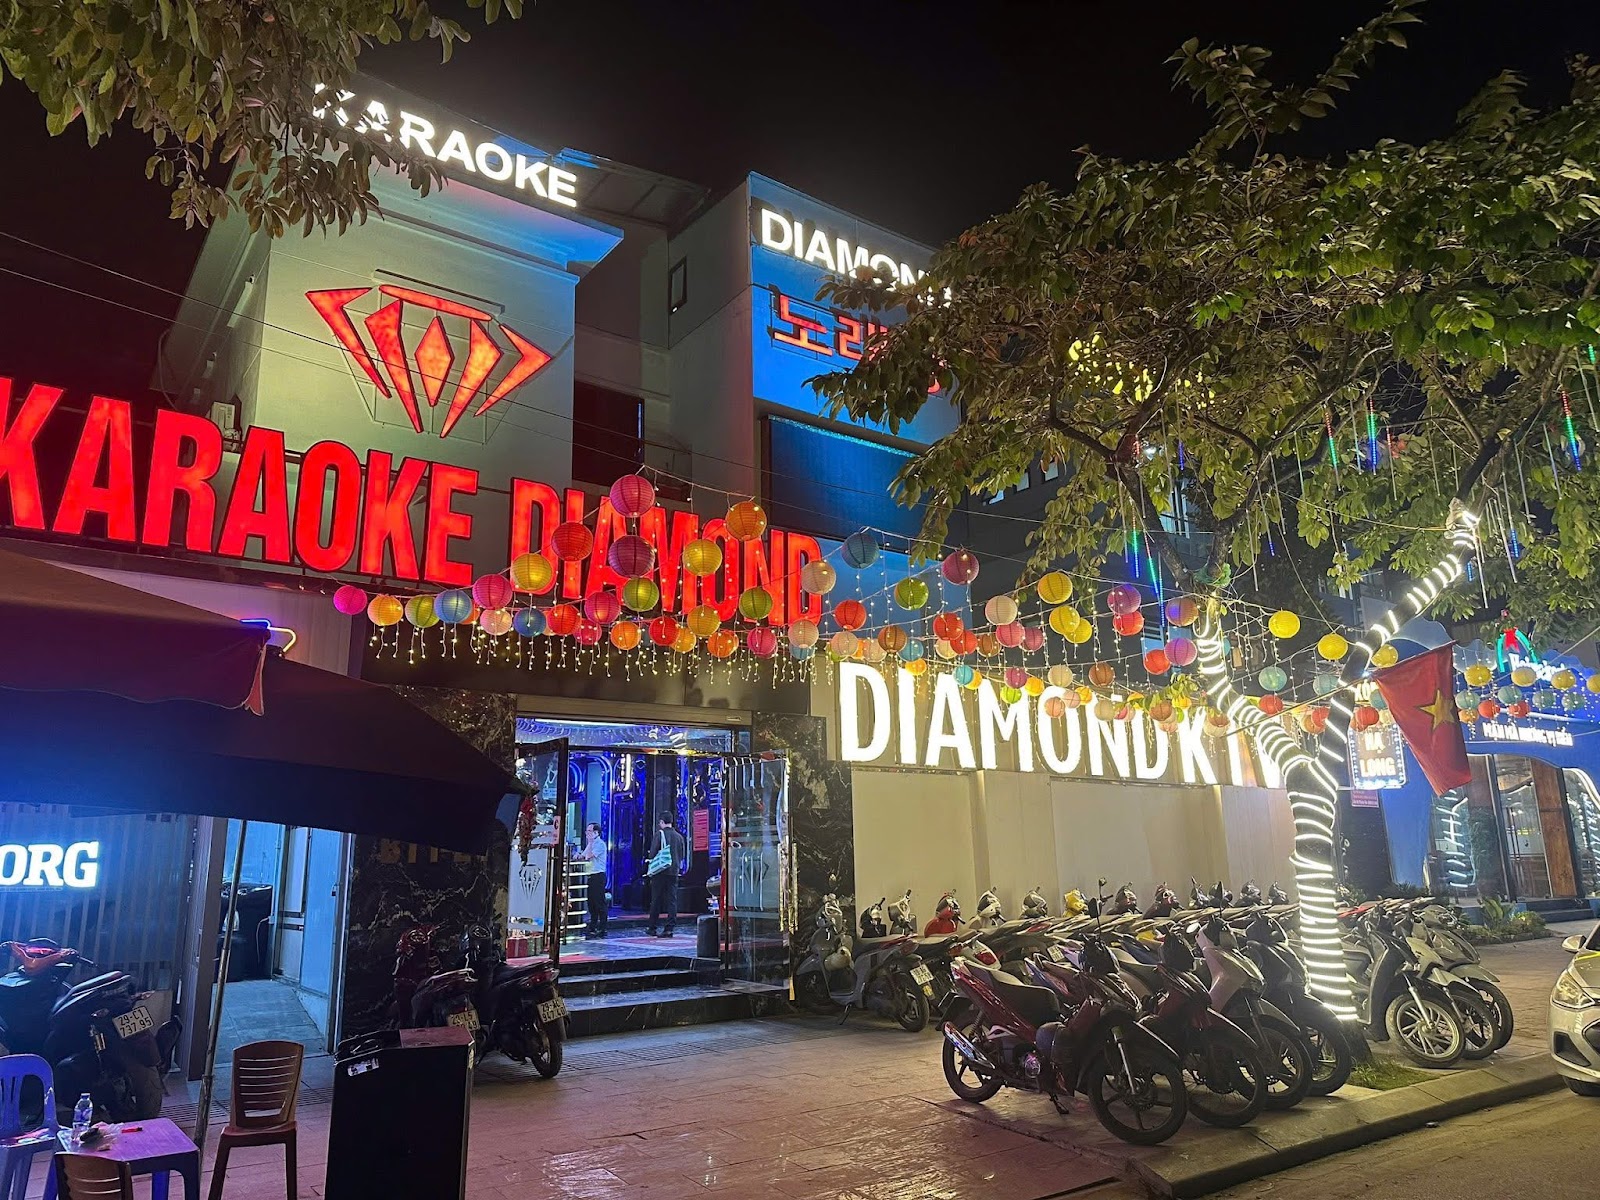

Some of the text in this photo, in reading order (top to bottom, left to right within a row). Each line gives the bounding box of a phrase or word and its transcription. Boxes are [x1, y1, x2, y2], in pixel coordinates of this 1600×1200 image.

[761, 207, 952, 308] DIAMON
[0, 376, 823, 627] KARAOKE DIAMOND
[839, 661, 1169, 780] DIAMOND
[1359, 757, 1397, 777] LONG
[0, 841, 99, 888] ORG
[118, 1009, 144, 1026] 29-C1
[120, 1016, 152, 1037] 737.95
